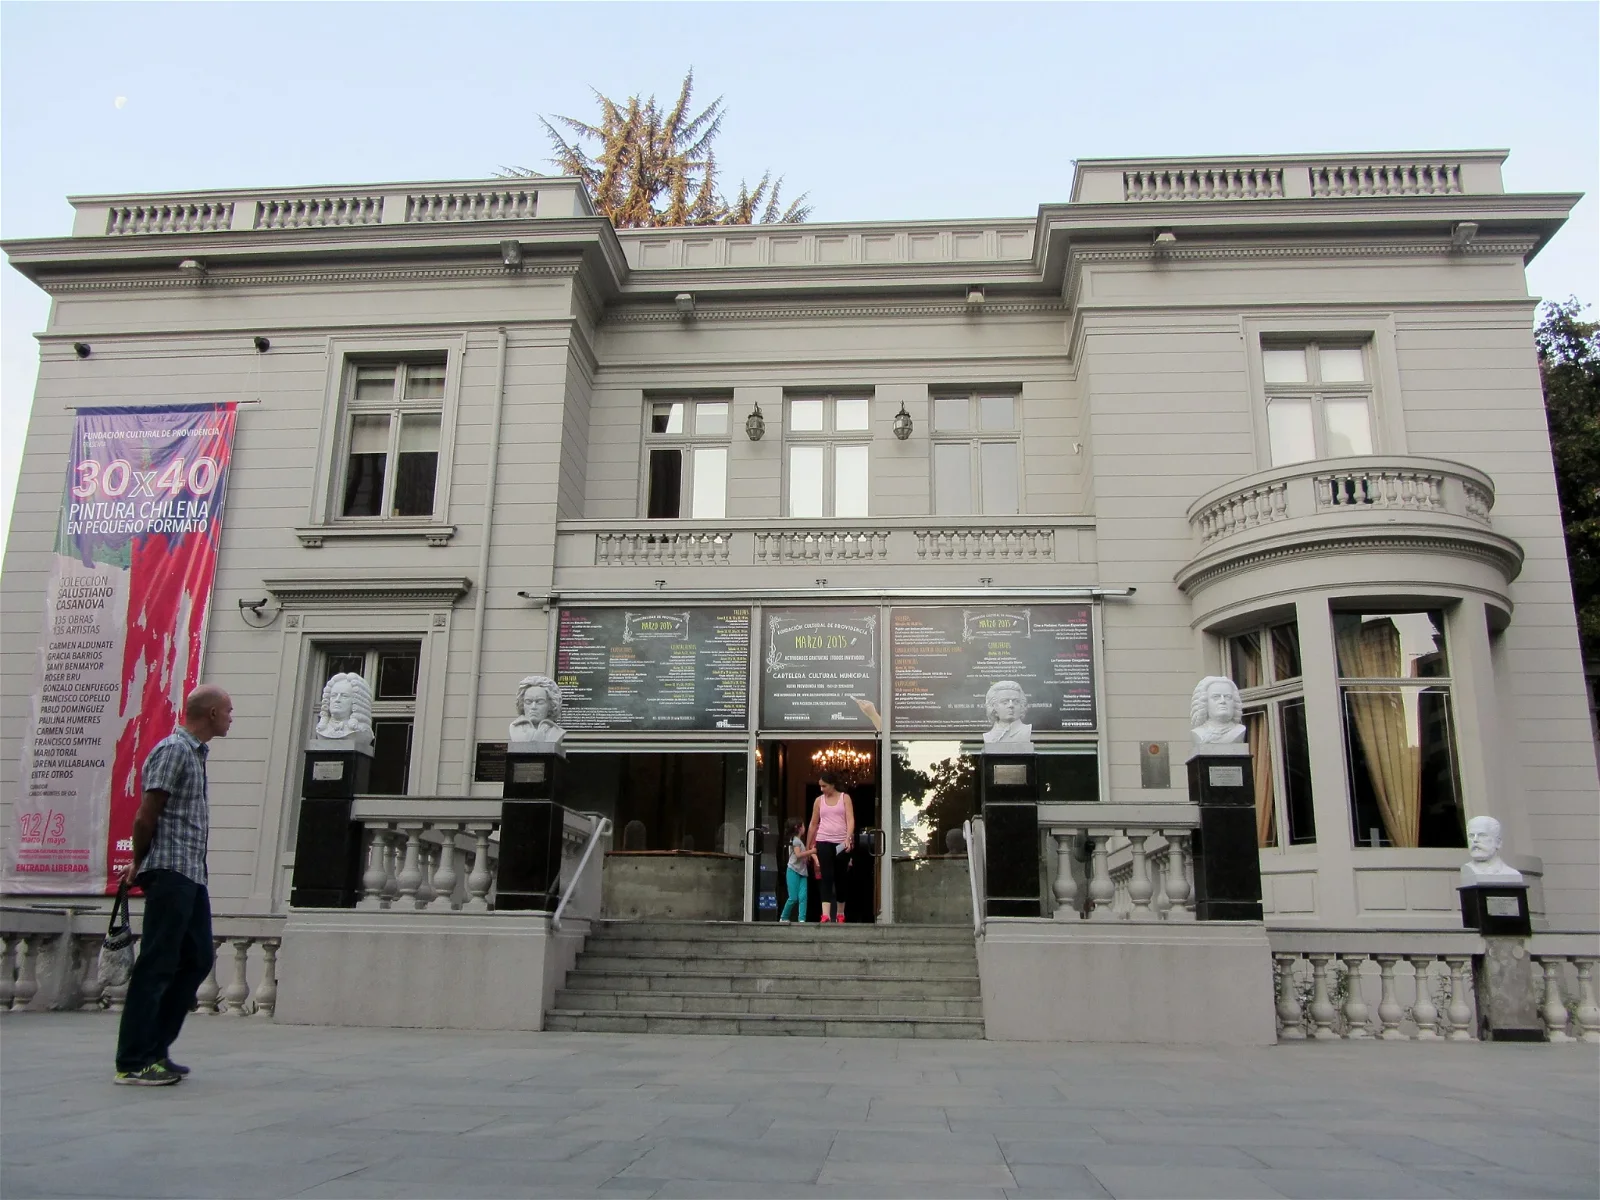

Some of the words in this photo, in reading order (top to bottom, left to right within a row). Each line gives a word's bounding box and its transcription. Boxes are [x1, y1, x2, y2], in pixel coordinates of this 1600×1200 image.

[84, 430, 124, 440] FUNDACIÓN
[126, 430, 161, 438] CULTURAL
[172, 428, 220, 437] PROVIDENCIA
[69, 502, 135, 520] PINTURA
[140, 501, 209, 519] CHILENA
[67, 521, 82, 534] EN
[85, 520, 144, 534] PEQUEÑO
[146, 518, 208, 532] FORMATO
[58, 588, 113, 599] SALUSTIANO
[56, 599, 104, 610] CASANOVA
[54, 615, 66, 624] 135
[68, 615, 93, 624] OBRAS
[53, 626, 64, 635] 135
[66, 625, 100, 634] ARTISTAS
[49, 642, 76, 650] CARMEN
[795, 635, 822, 648] MARZO
[827, 635, 847, 648] 2015
[38, 716, 65, 725] PAULINA
[47, 837, 66, 845] mayo
[16, 864, 49, 872] ENTRADA
[51, 863, 89, 872] LIBERADA
